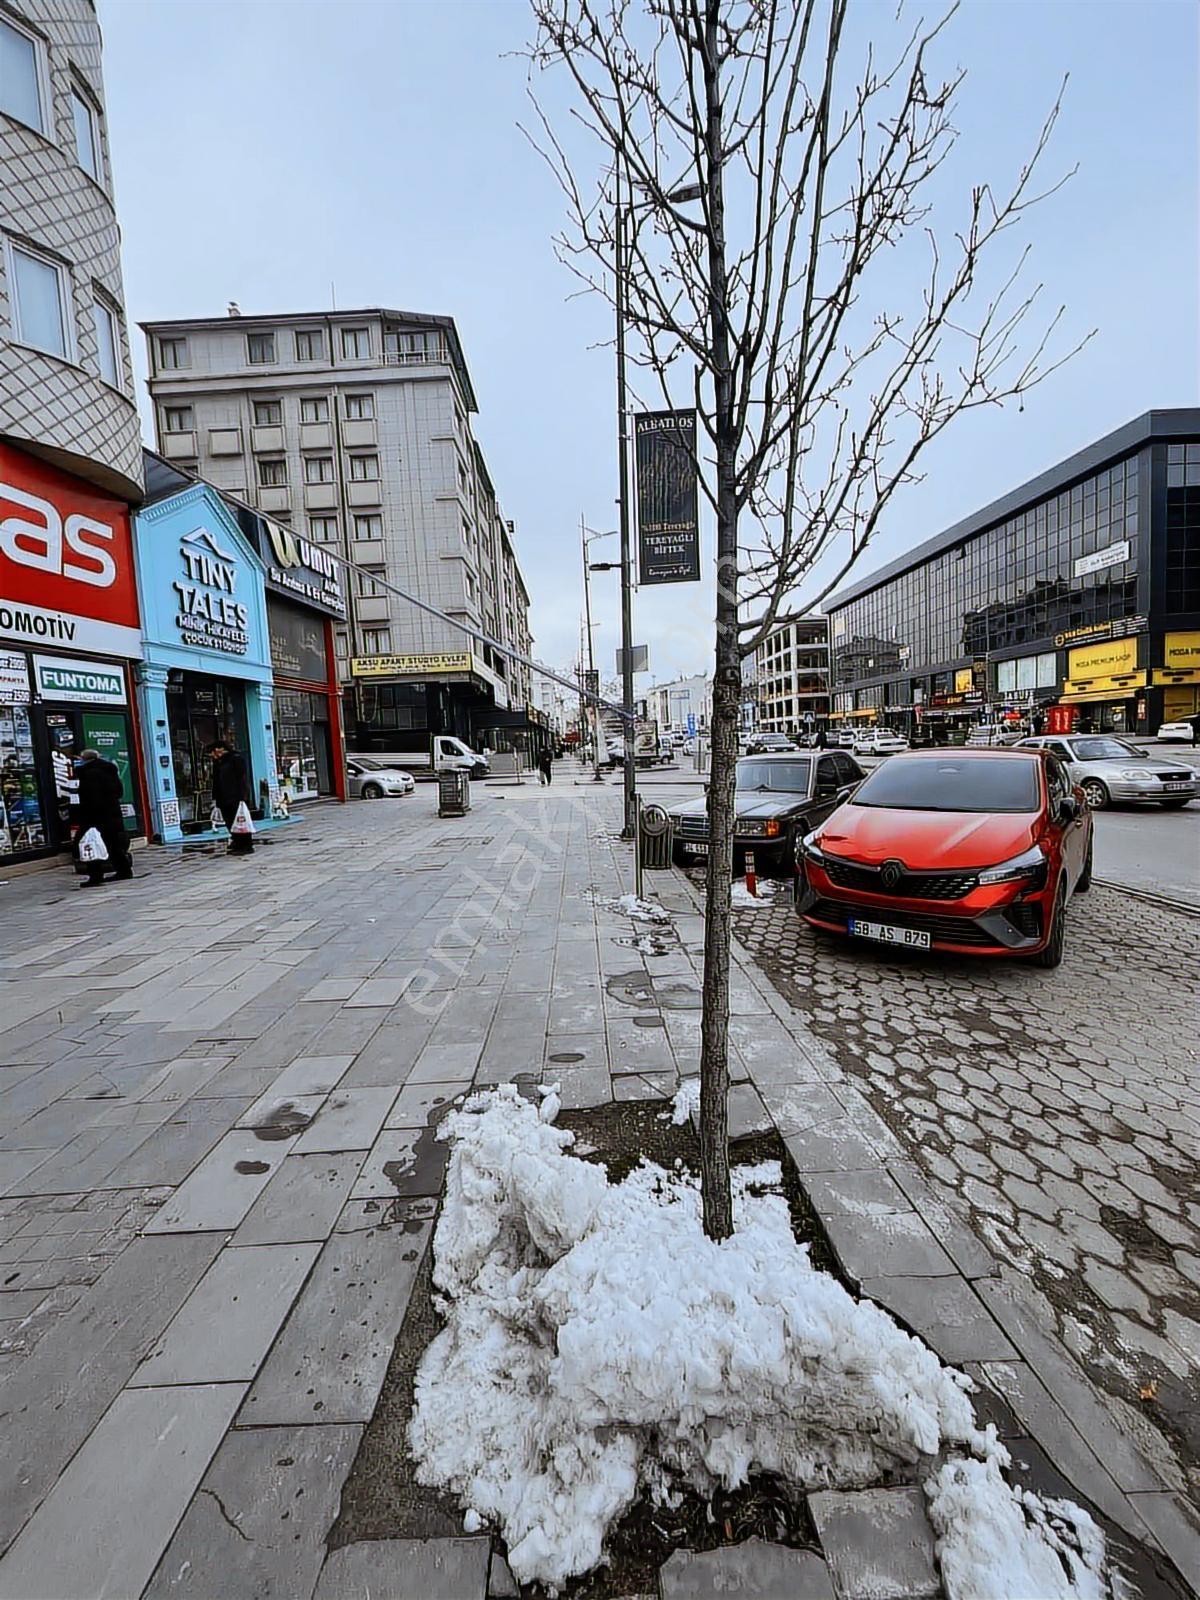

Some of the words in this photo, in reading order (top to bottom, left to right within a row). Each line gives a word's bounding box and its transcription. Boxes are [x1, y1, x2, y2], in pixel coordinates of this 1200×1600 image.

[181, 547, 238, 594] TINY
[175, 581, 249, 631] TALES
[41, 670, 120, 692] FUNTOMA
[854, 921, 870, 936] 58
[879, 926, 895, 940] AS
[904, 930, 929, 947] 879
